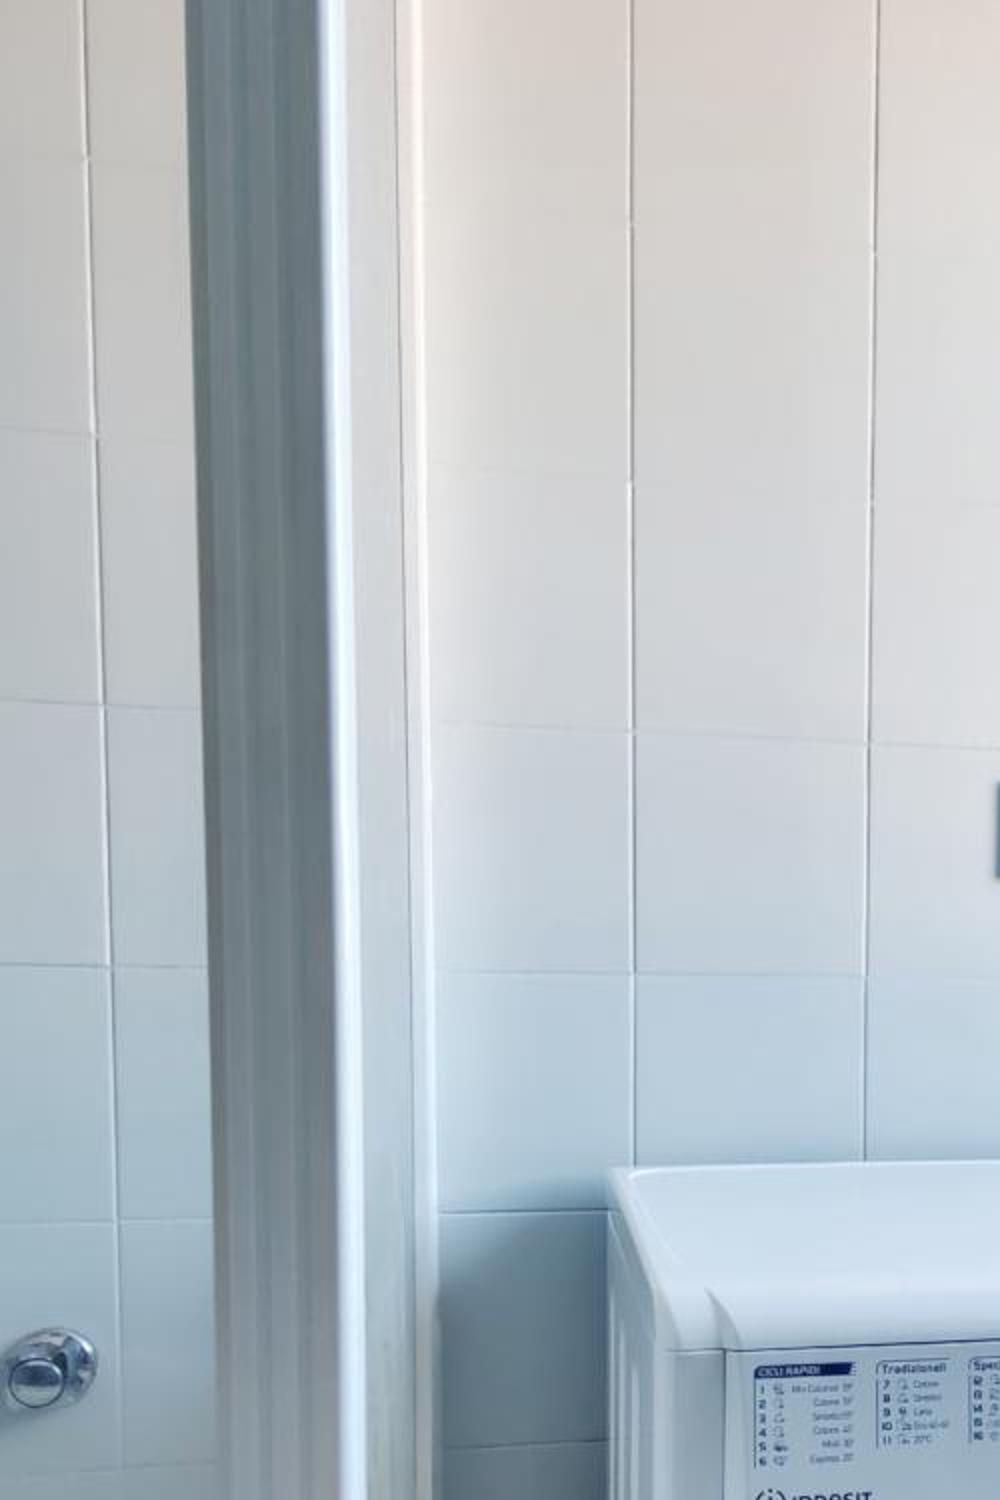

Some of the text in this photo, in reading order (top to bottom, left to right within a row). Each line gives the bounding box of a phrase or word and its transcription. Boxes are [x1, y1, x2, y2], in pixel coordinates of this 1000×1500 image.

[882, 1362, 946, 1374] Tradizionali
[882, 1380, 891, 1390] 7
[881, 1422, 893, 1431] 10
[758, 1428, 767, 1437] 4
[758, 1441, 767, 1451] 5
[758, 1457, 767, 1467] 6
